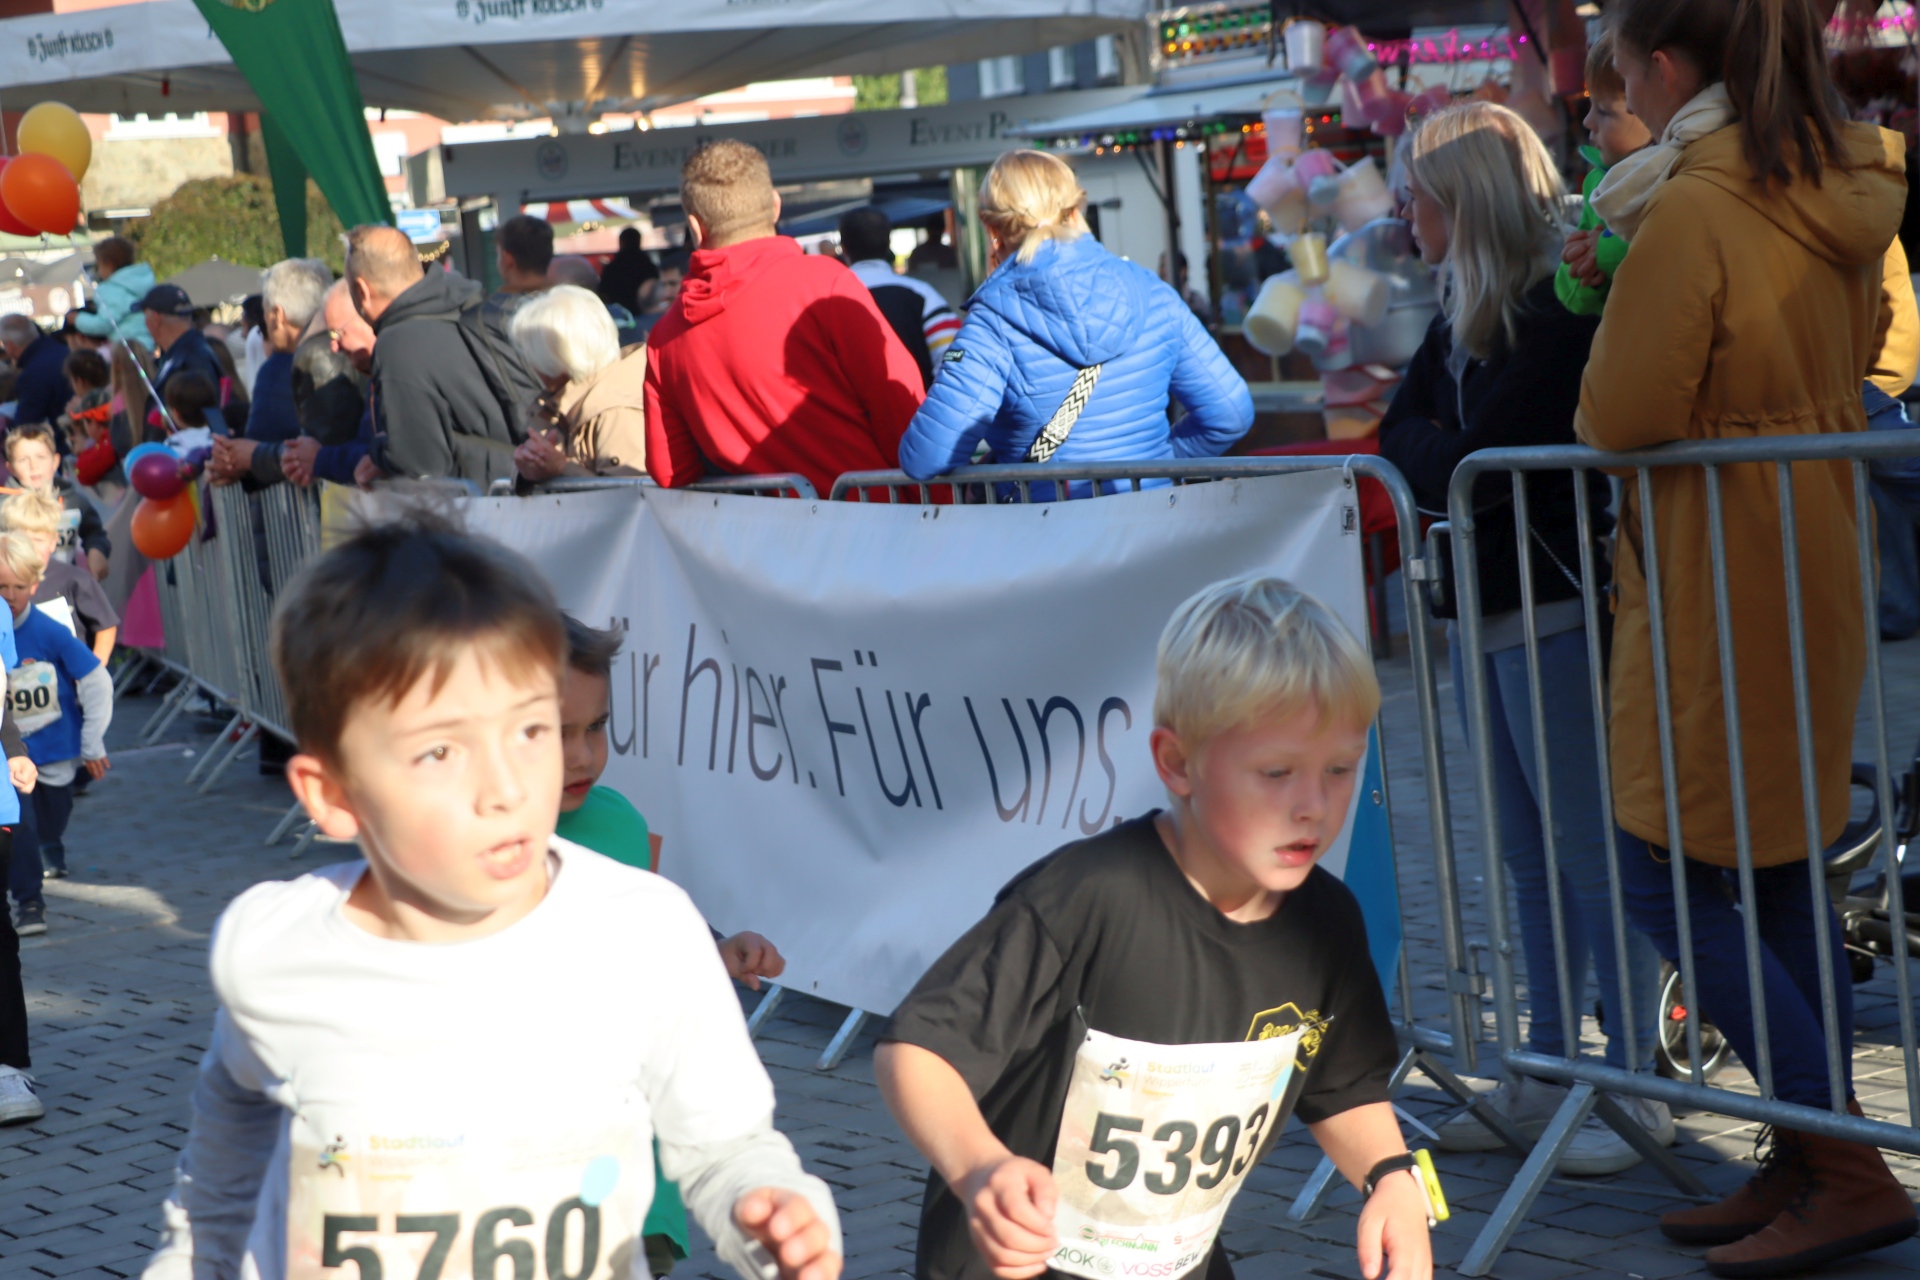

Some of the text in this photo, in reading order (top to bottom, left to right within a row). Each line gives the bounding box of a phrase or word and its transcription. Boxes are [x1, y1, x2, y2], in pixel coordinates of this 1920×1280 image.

[608, 616, 660, 758] ür
[811, 649, 944, 810] Für
[963, 695, 1133, 836] uns.
[1146, 1060, 1216, 1075] Stadtlauf
[1085, 1102, 1269, 1196] 5393
[321, 1196, 602, 1280] 5760
[1054, 1246, 1096, 1269] AOK
